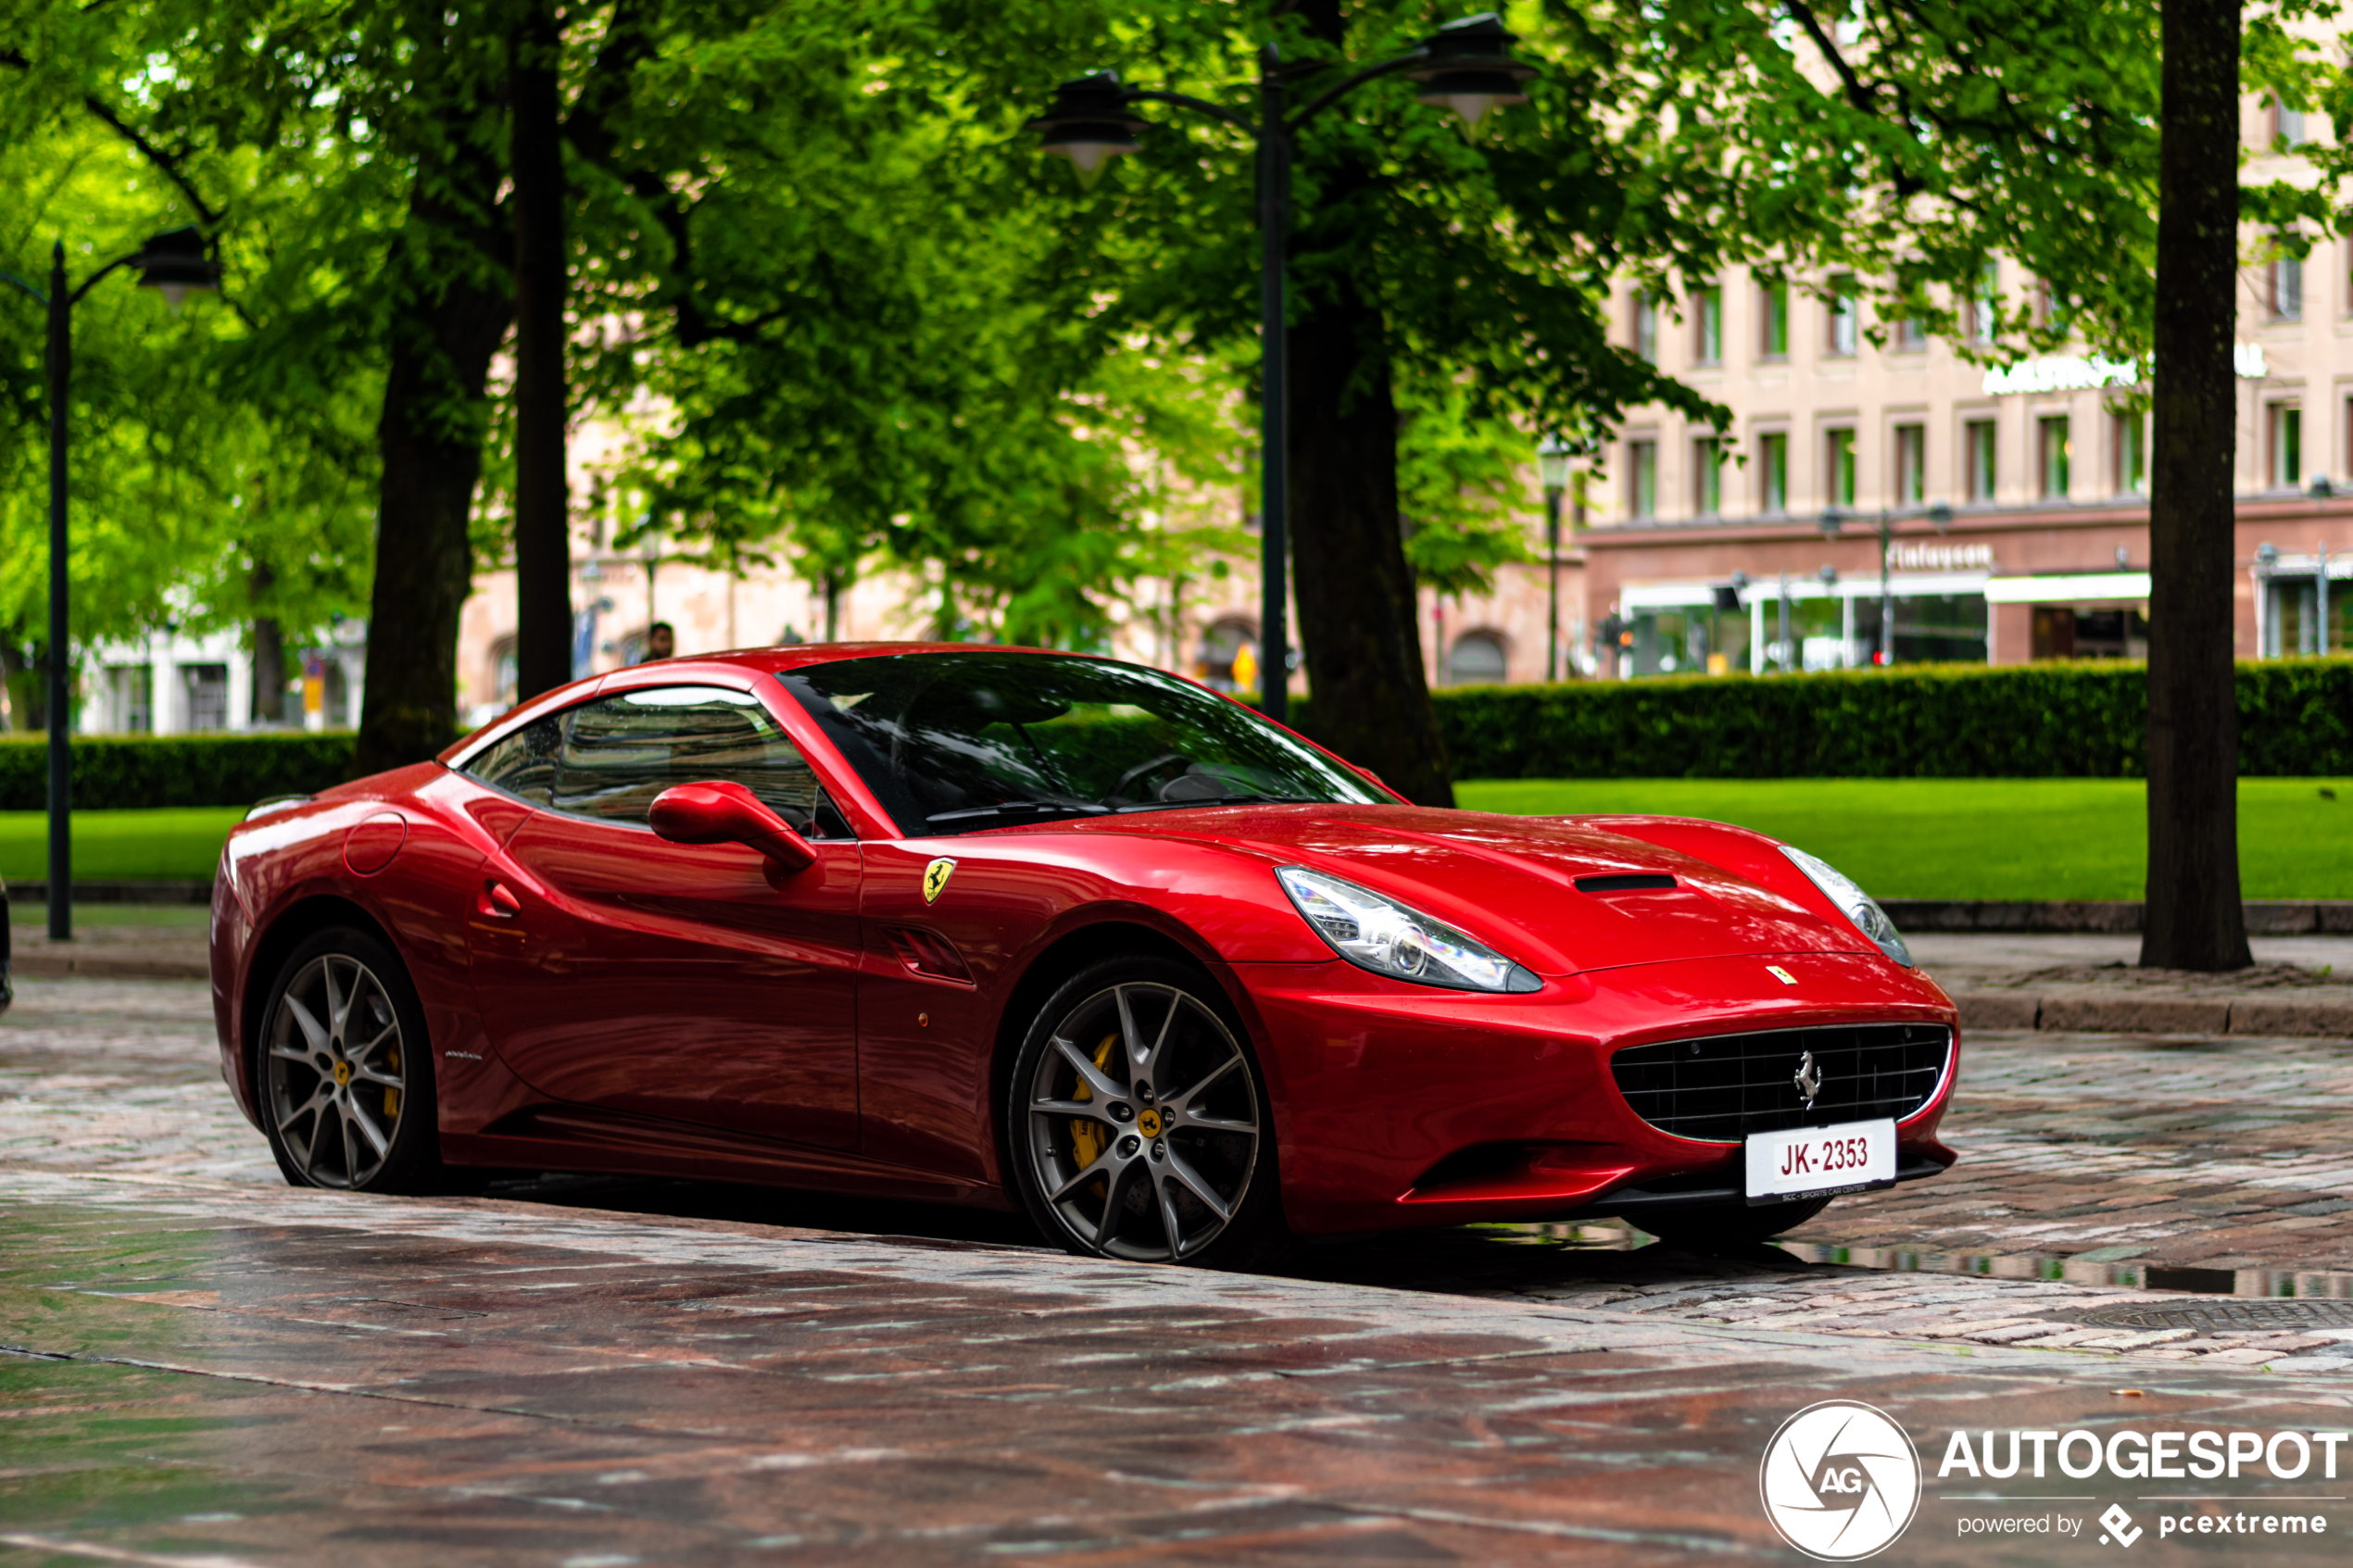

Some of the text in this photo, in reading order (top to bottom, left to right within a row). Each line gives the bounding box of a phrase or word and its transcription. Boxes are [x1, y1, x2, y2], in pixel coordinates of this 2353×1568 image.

[1781, 1137, 1868, 1175] JK-2353
[1801, 1189, 1828, 1199] SPORTS
[1829, 1186, 1842, 1196] CAR
[1843, 1185, 1866, 1193] CENTER
